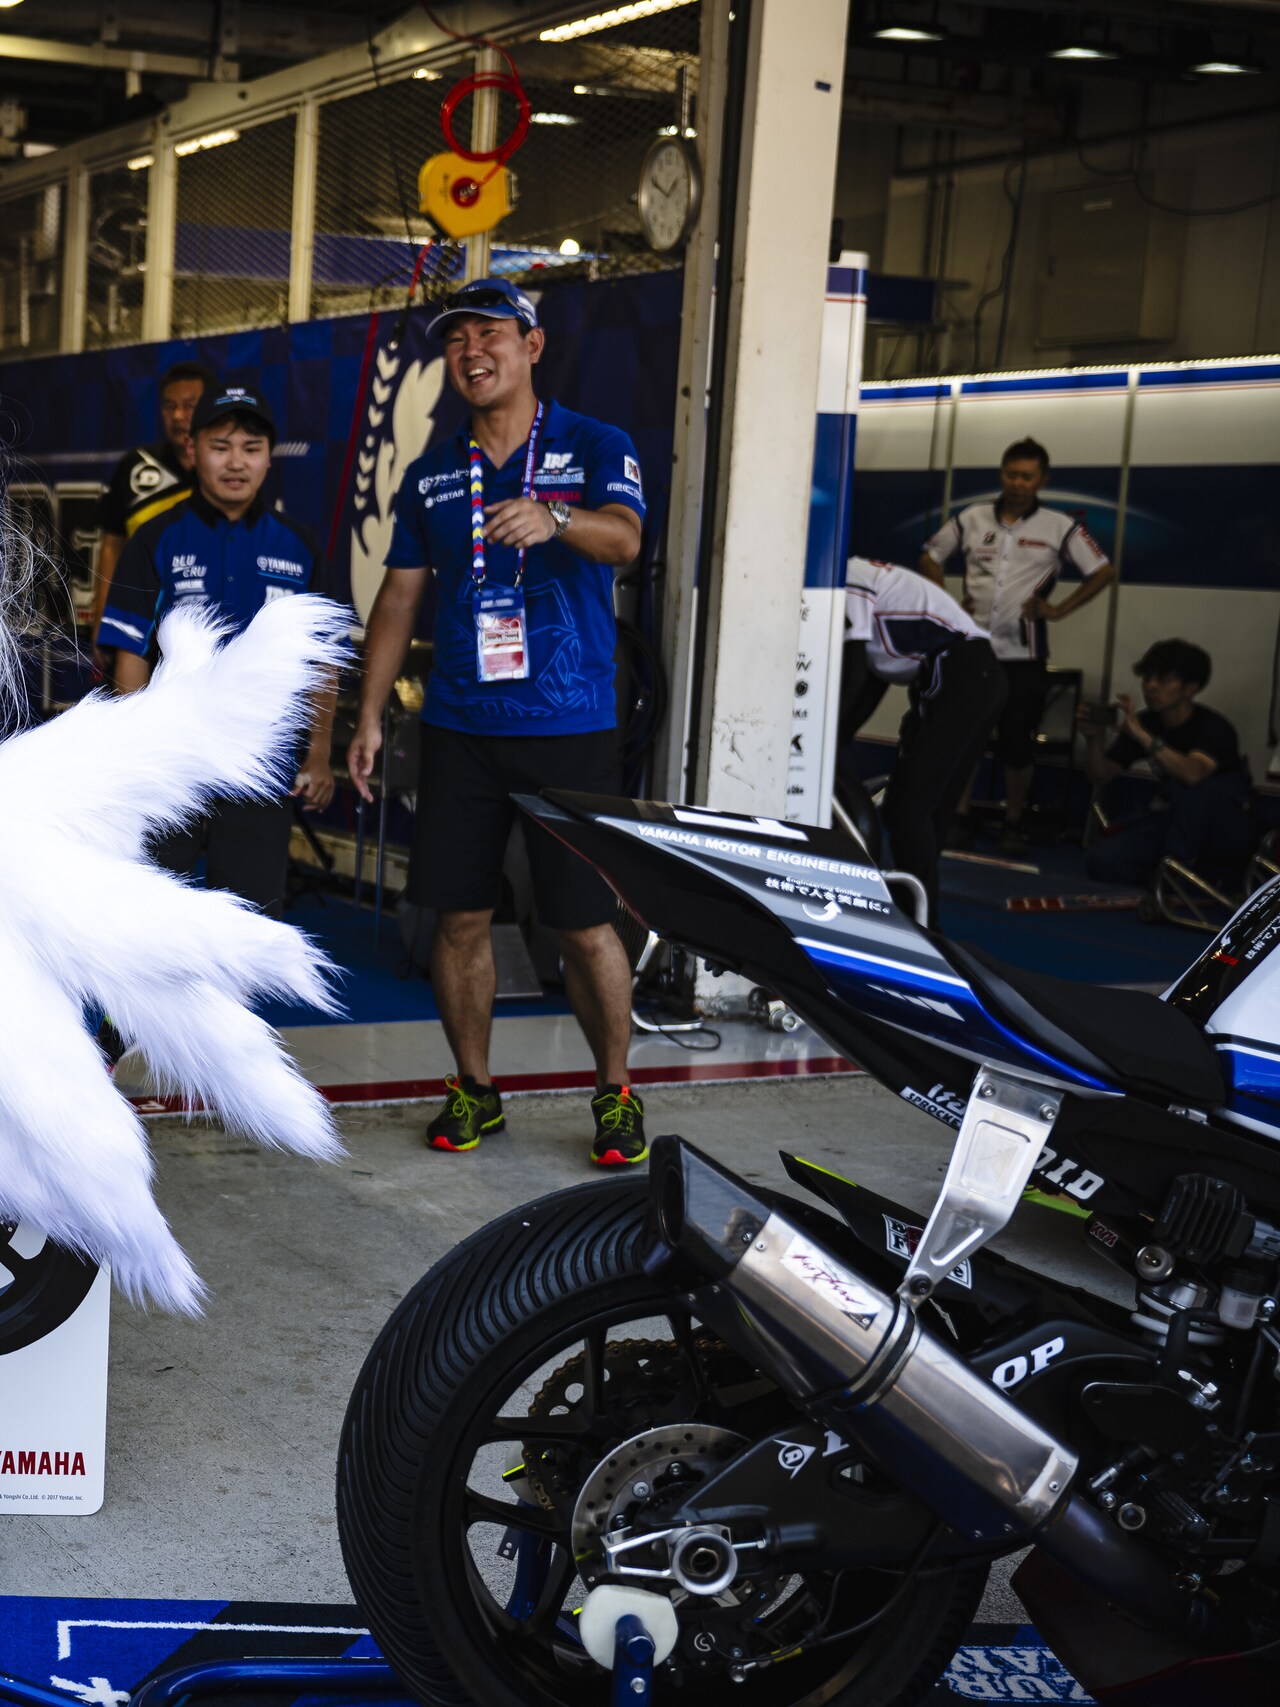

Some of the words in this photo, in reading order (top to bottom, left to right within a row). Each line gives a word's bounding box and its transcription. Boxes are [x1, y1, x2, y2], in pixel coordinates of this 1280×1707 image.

[267, 557, 304, 575] YAMAHA
[637, 825, 700, 847] YAMAHA
[705, 838, 761, 858] MOTOR
[766, 850, 881, 882] ENGINEERING
[785, 875, 834, 893] Engineering
[906, 1092, 962, 1129] SPROCKE
